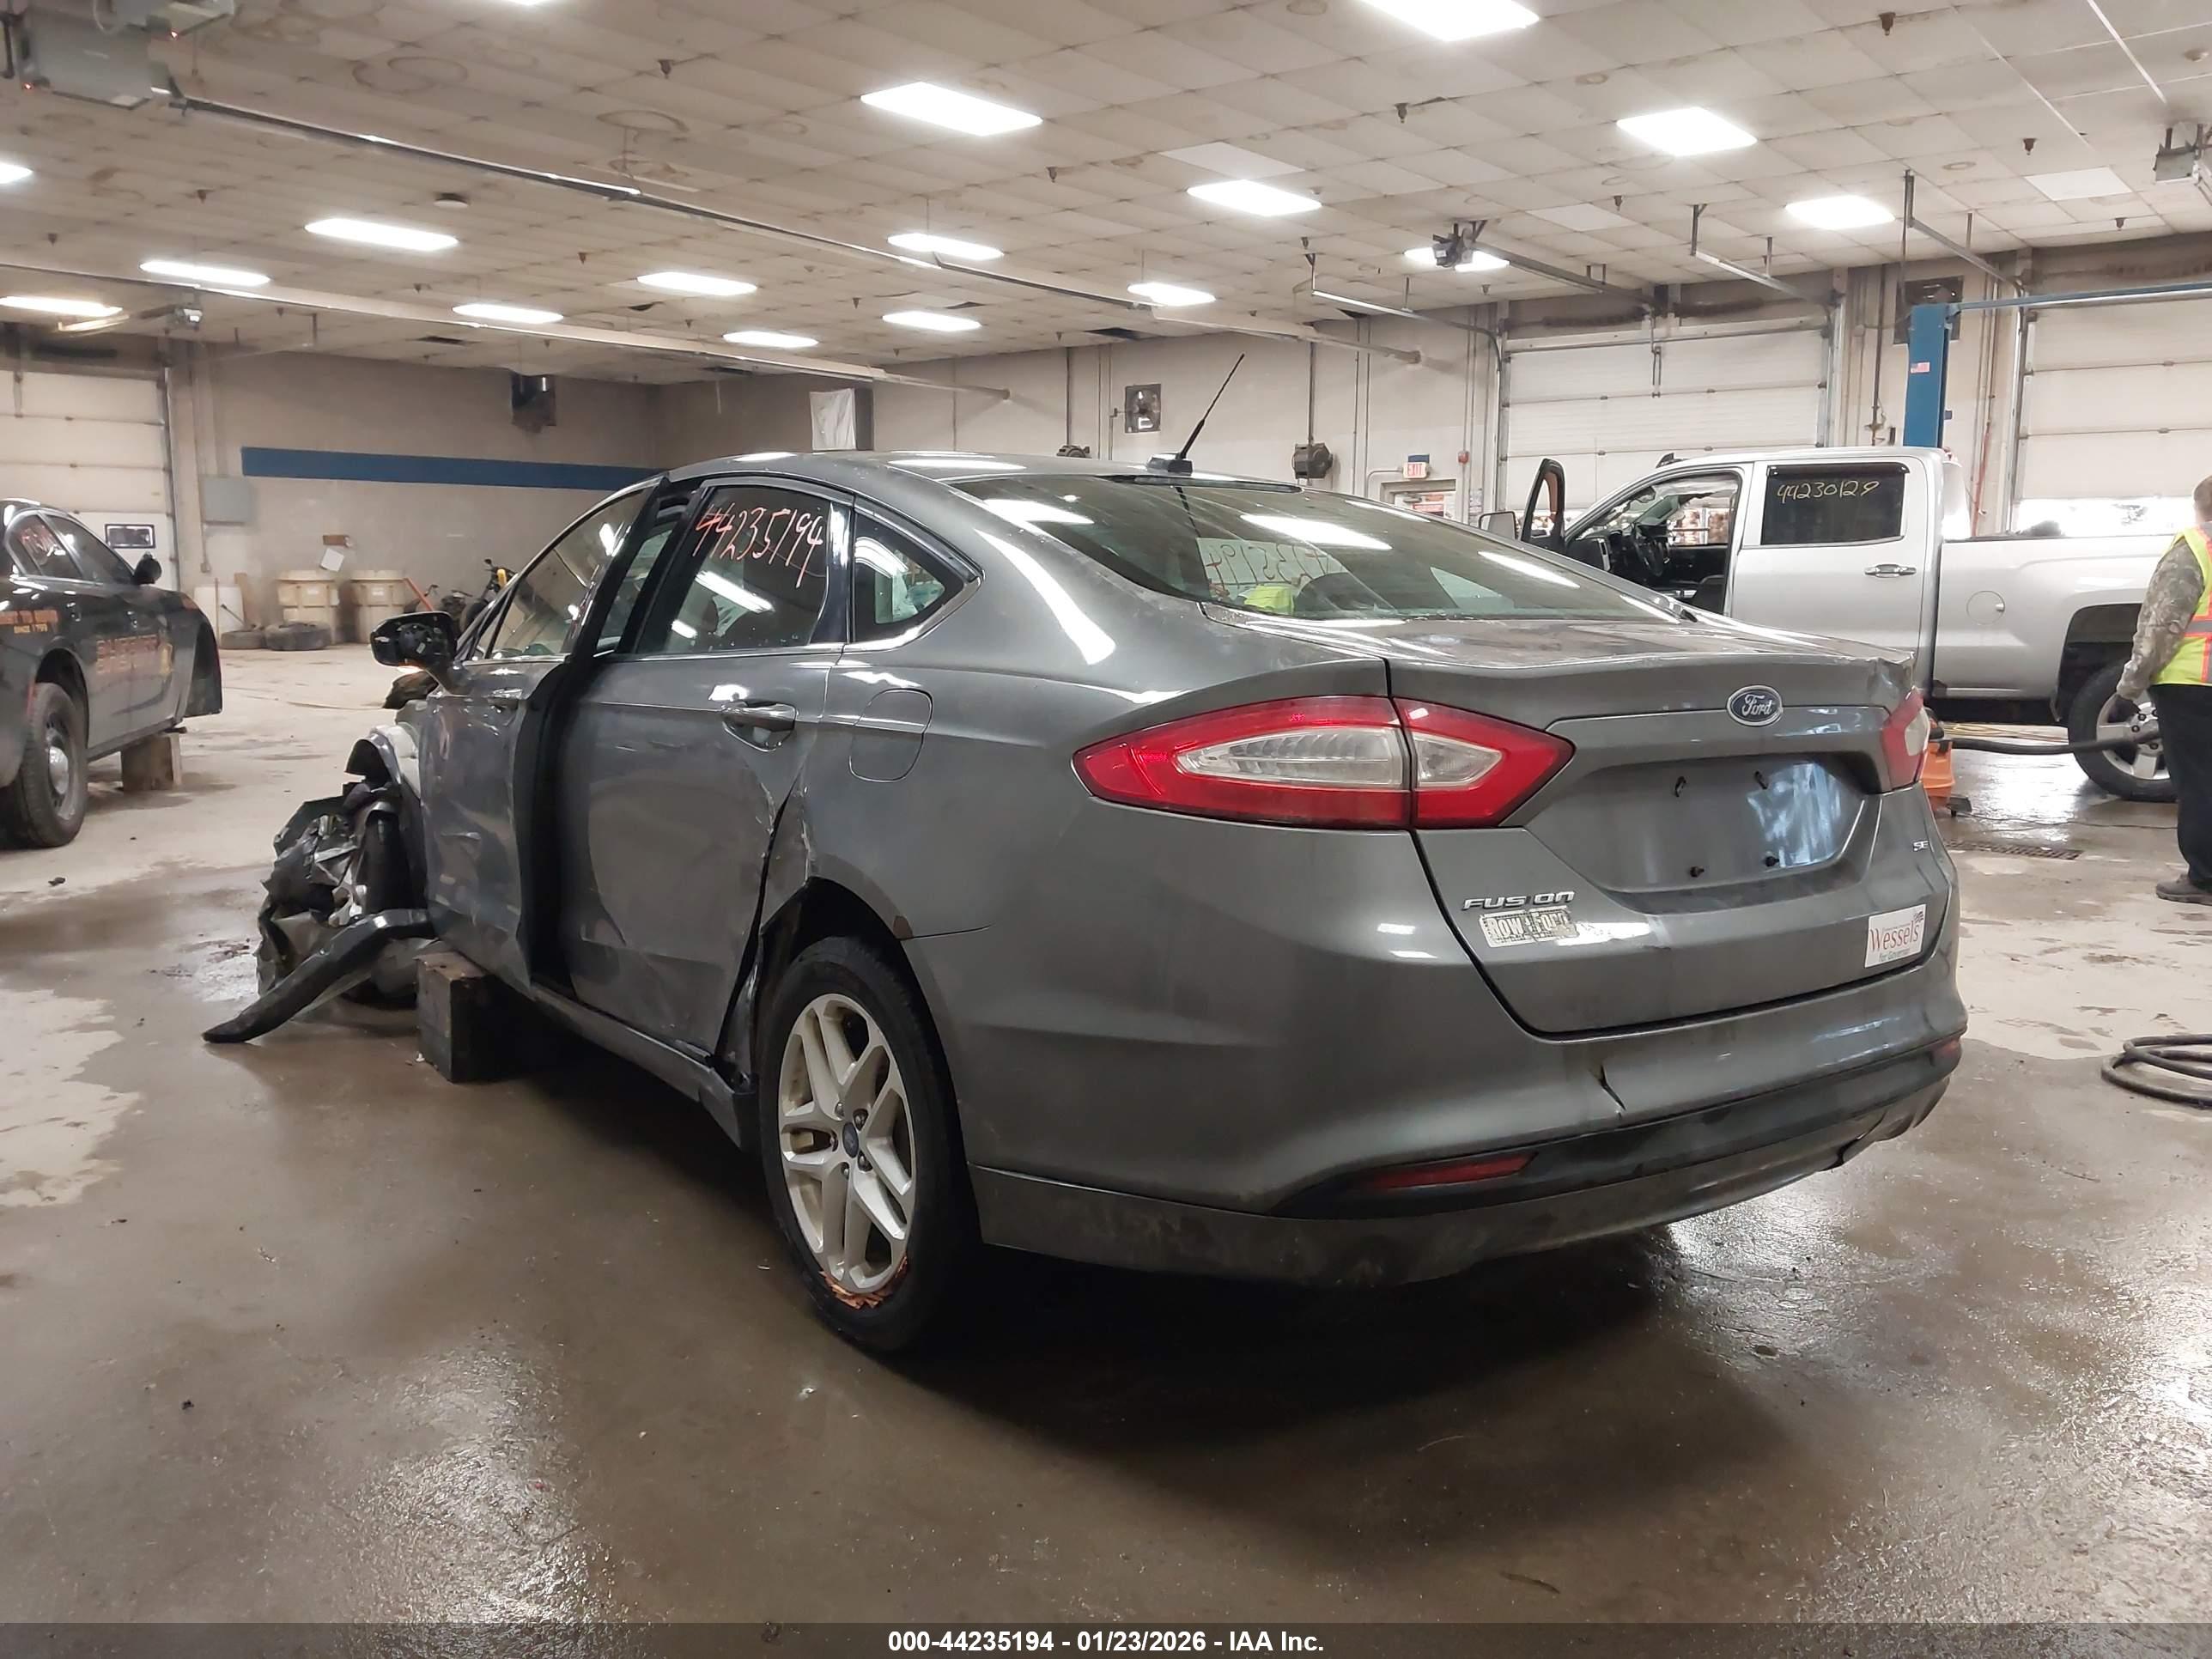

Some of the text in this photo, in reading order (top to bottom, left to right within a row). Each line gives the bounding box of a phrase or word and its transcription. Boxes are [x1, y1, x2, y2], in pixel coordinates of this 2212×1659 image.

[692, 502, 823, 588] 44235194
[1741, 694, 1773, 716] Ford
[1913, 840, 1929, 852] SE
[1870, 921, 1919, 951] Wessels
